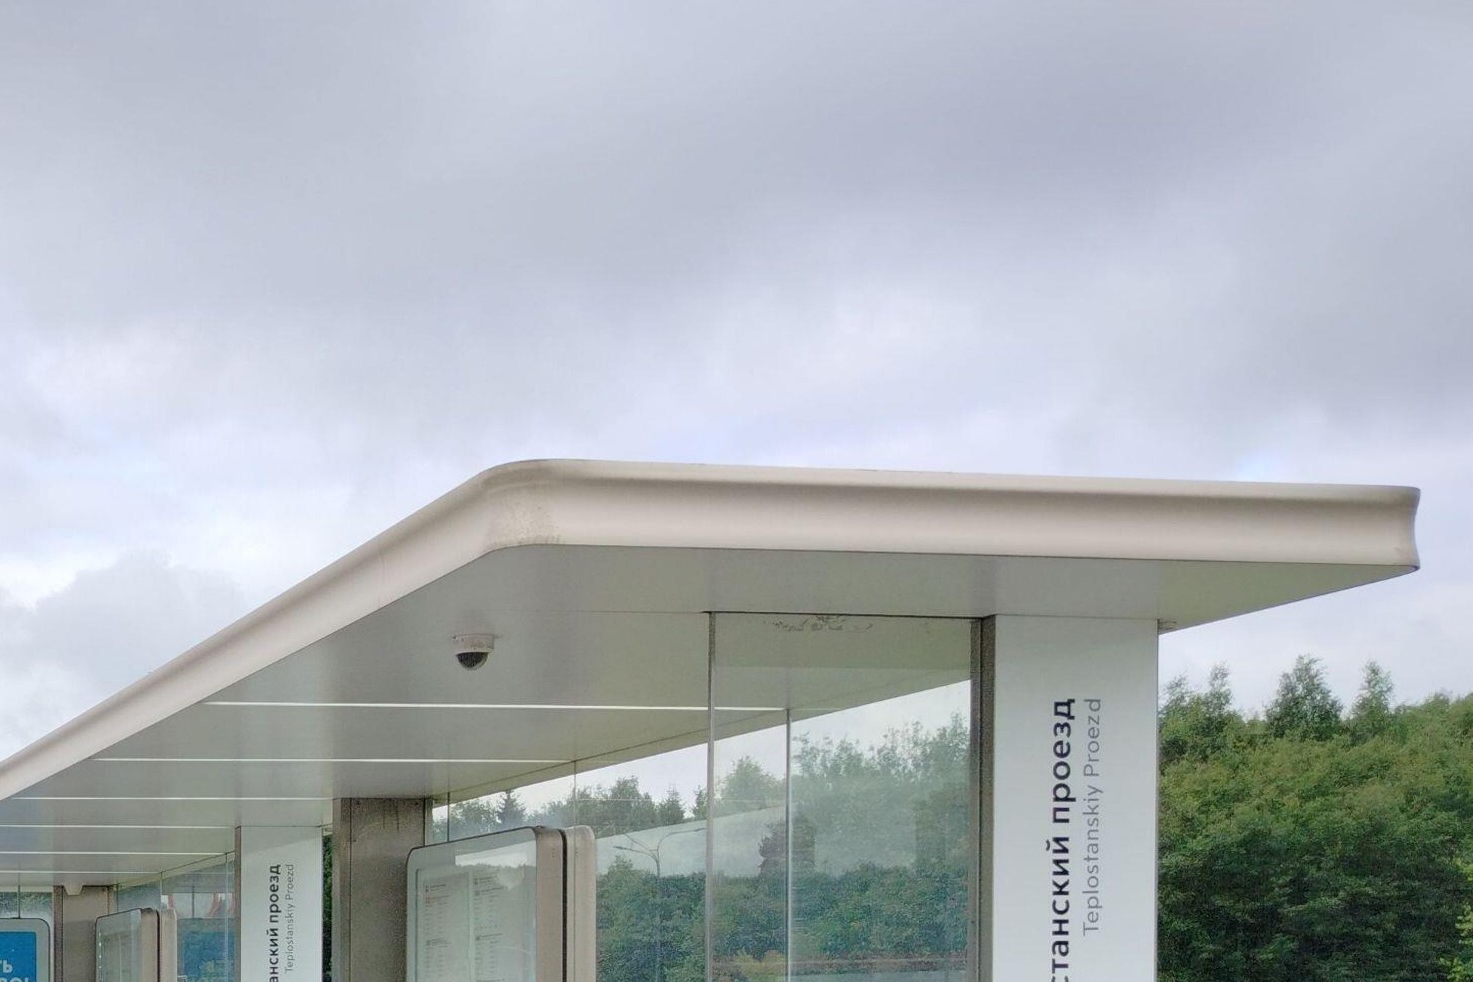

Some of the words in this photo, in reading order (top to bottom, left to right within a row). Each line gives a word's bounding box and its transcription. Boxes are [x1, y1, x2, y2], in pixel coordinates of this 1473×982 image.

[1051, 699, 1076, 824] проезд
[1083, 698, 1101, 778] Proezd
[269, 864, 282, 923] проезд
[285, 864, 294, 900] Proezd
[1083, 784, 1104, 936] Teplostanskiy
[285, 903, 295, 973] Teplostanskiy
